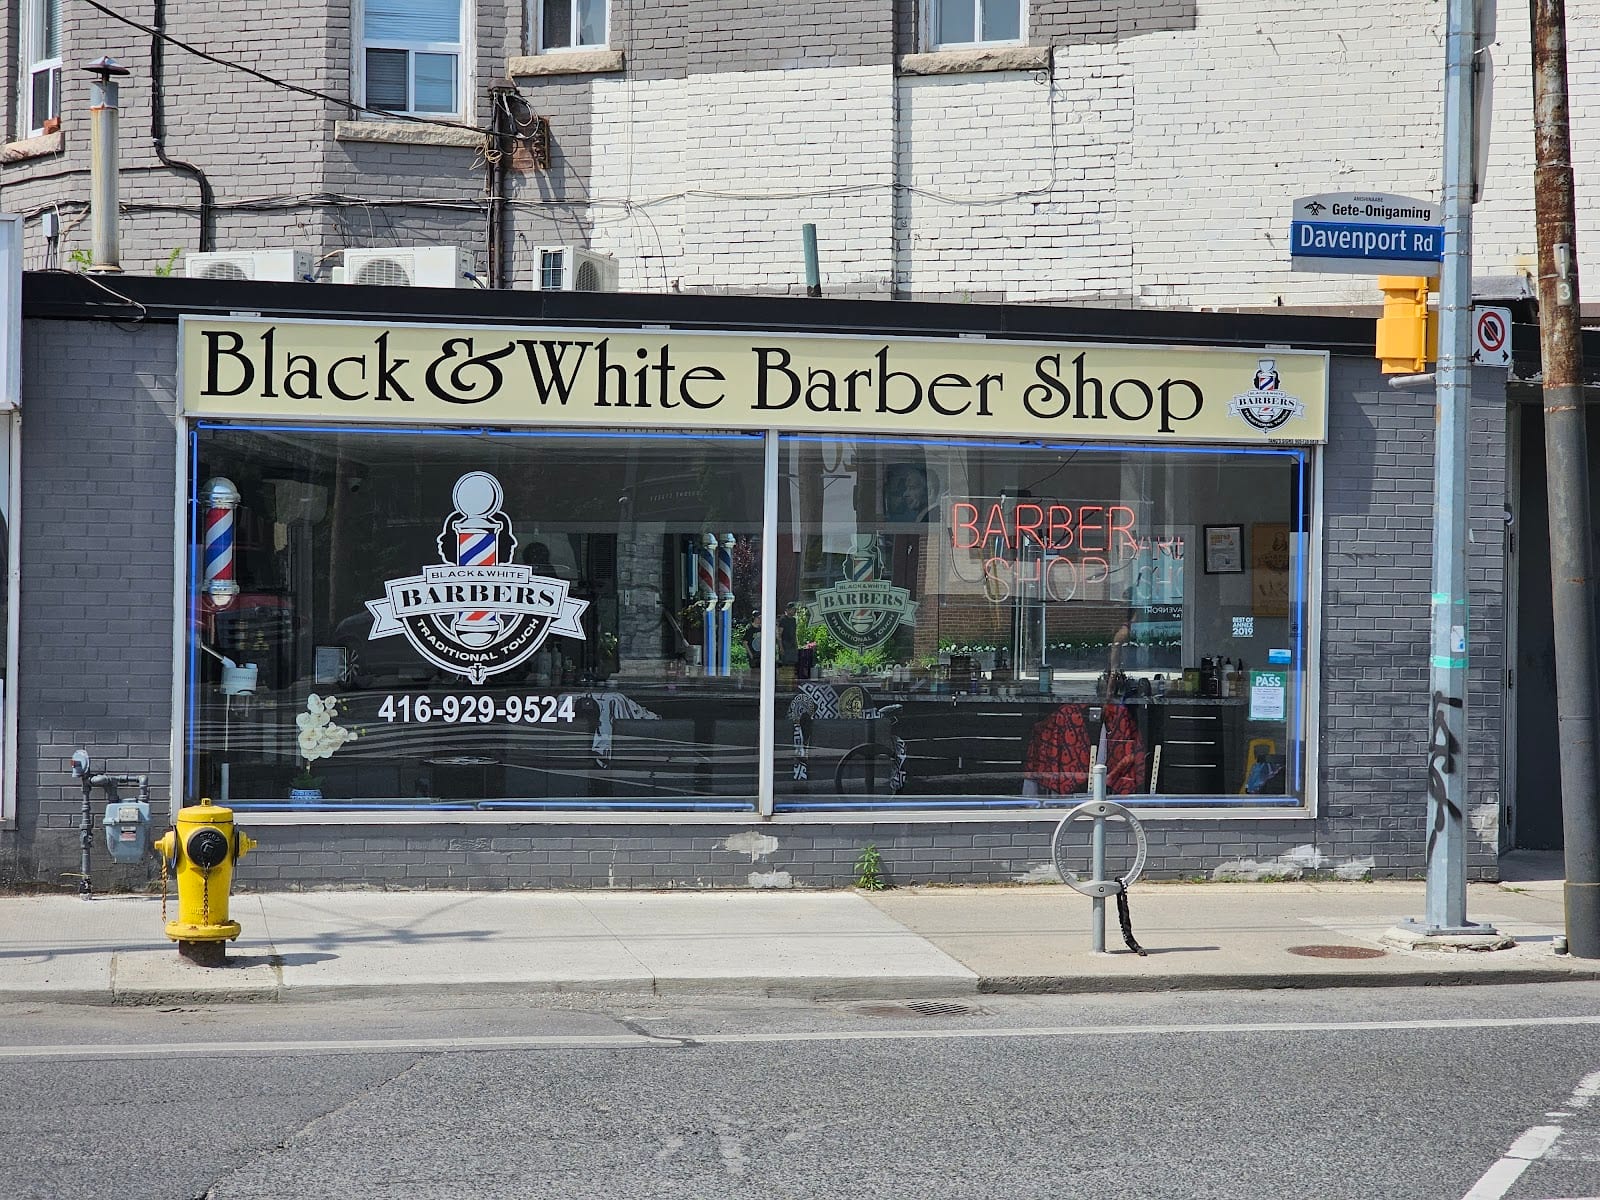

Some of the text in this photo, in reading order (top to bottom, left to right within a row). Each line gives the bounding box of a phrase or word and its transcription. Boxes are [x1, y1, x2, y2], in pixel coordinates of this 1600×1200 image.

[1332, 203, 1431, 221] Gete-Onigaming
[1300, 224, 1433, 255] Davenport Rd
[200, 326, 1204, 433] Black & White Barber Shop
[1239, 397, 1295, 407] BARBERS
[952, 502, 1139, 551] BARBER
[431, 570, 474, 579] BLACK
[486, 570, 525, 579] WHITE
[983, 556, 1109, 602] SHOP
[401, 584, 556, 609] BARBERS
[823, 592, 903, 609] BARBERS
[416, 618, 540, 662] TRADITIONAL TOUCH
[831, 615, 873, 642] TRADITIONAL
[1255, 676, 1281, 687] PASS
[377, 695, 576, 723] 416-929-9524
